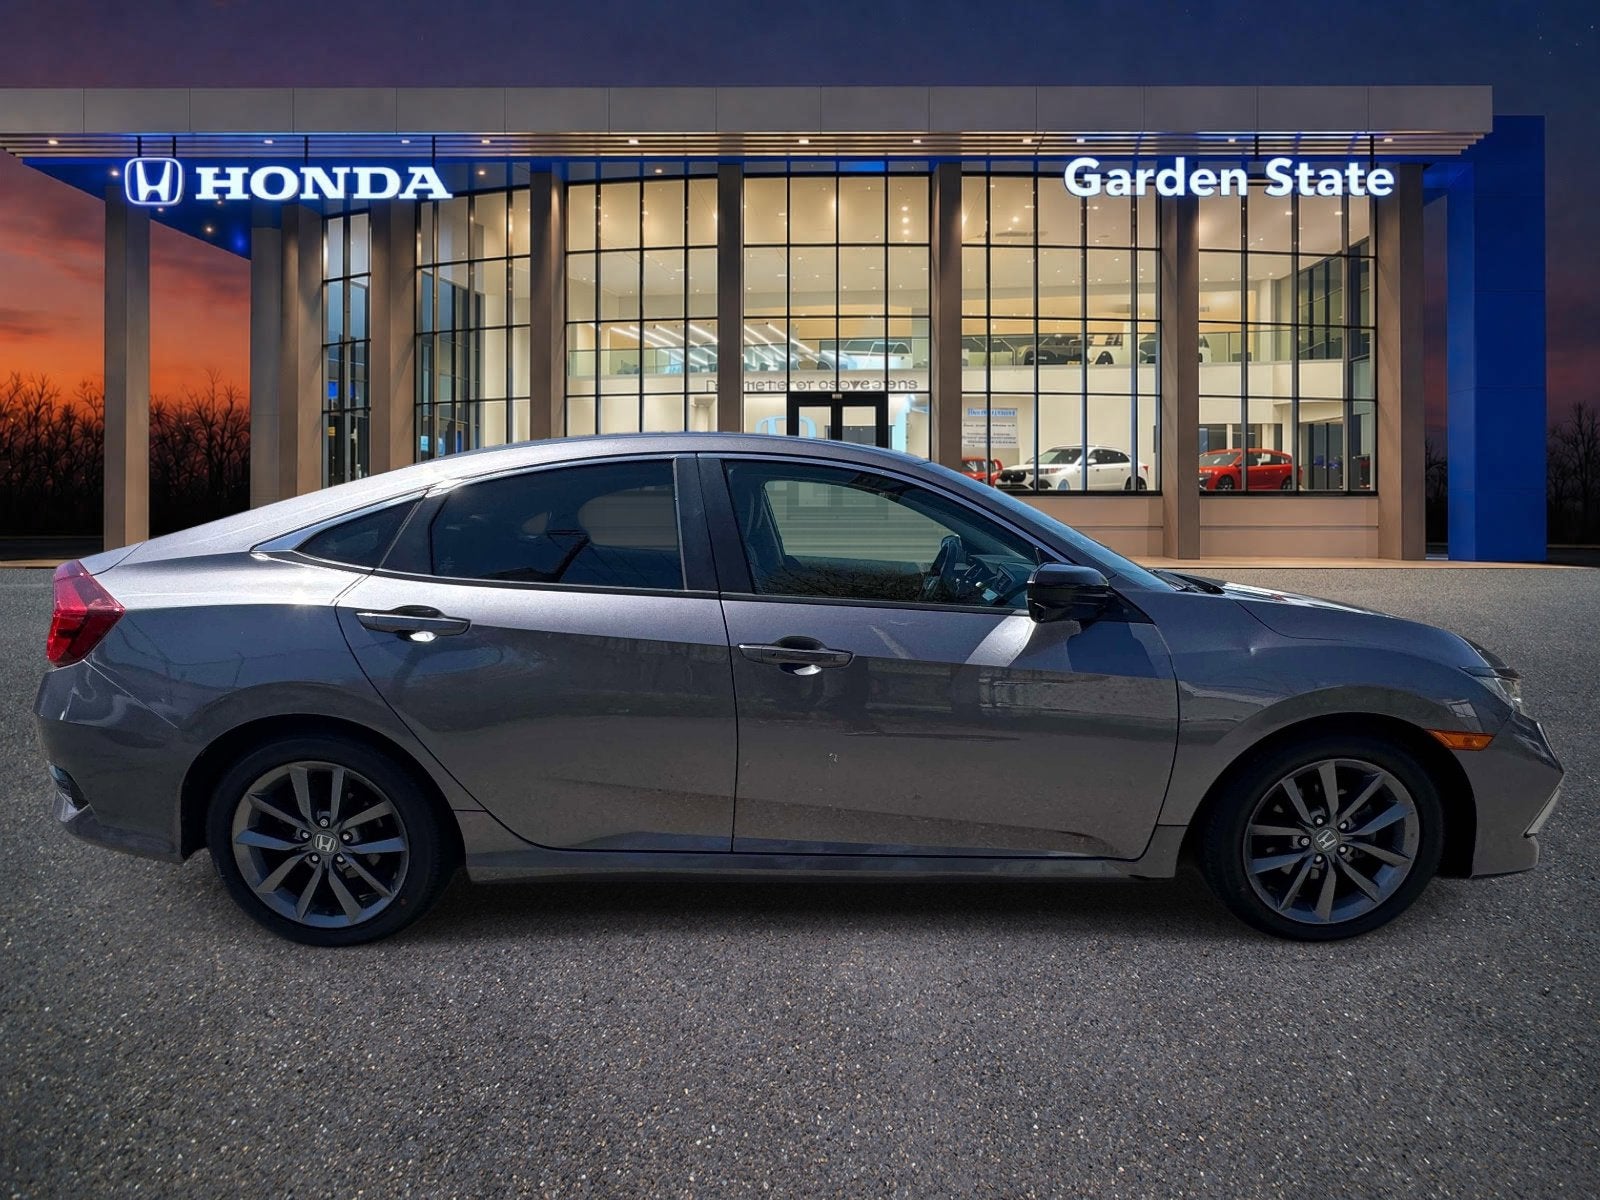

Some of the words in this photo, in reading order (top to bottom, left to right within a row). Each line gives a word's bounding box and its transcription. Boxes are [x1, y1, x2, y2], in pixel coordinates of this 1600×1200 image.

[195, 166, 453, 201] HONDA
[1064, 157, 1247, 197] Garden
[1265, 157, 1395, 197] State
